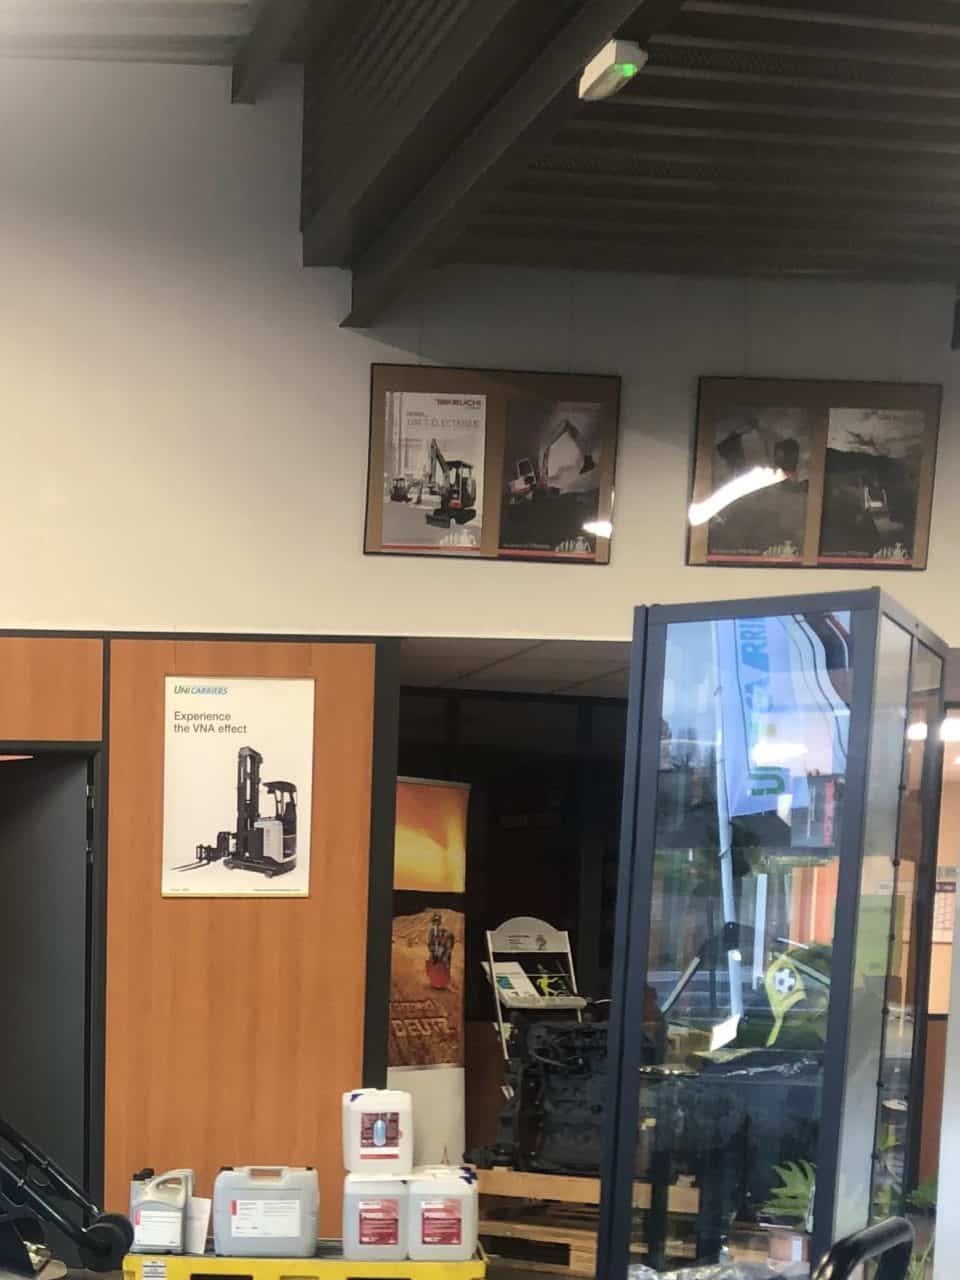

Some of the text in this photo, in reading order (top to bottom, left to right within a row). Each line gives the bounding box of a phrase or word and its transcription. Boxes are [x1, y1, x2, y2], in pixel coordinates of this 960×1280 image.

[174, 711, 232, 722] Experience
[174, 723, 247, 733] the VNA effect
